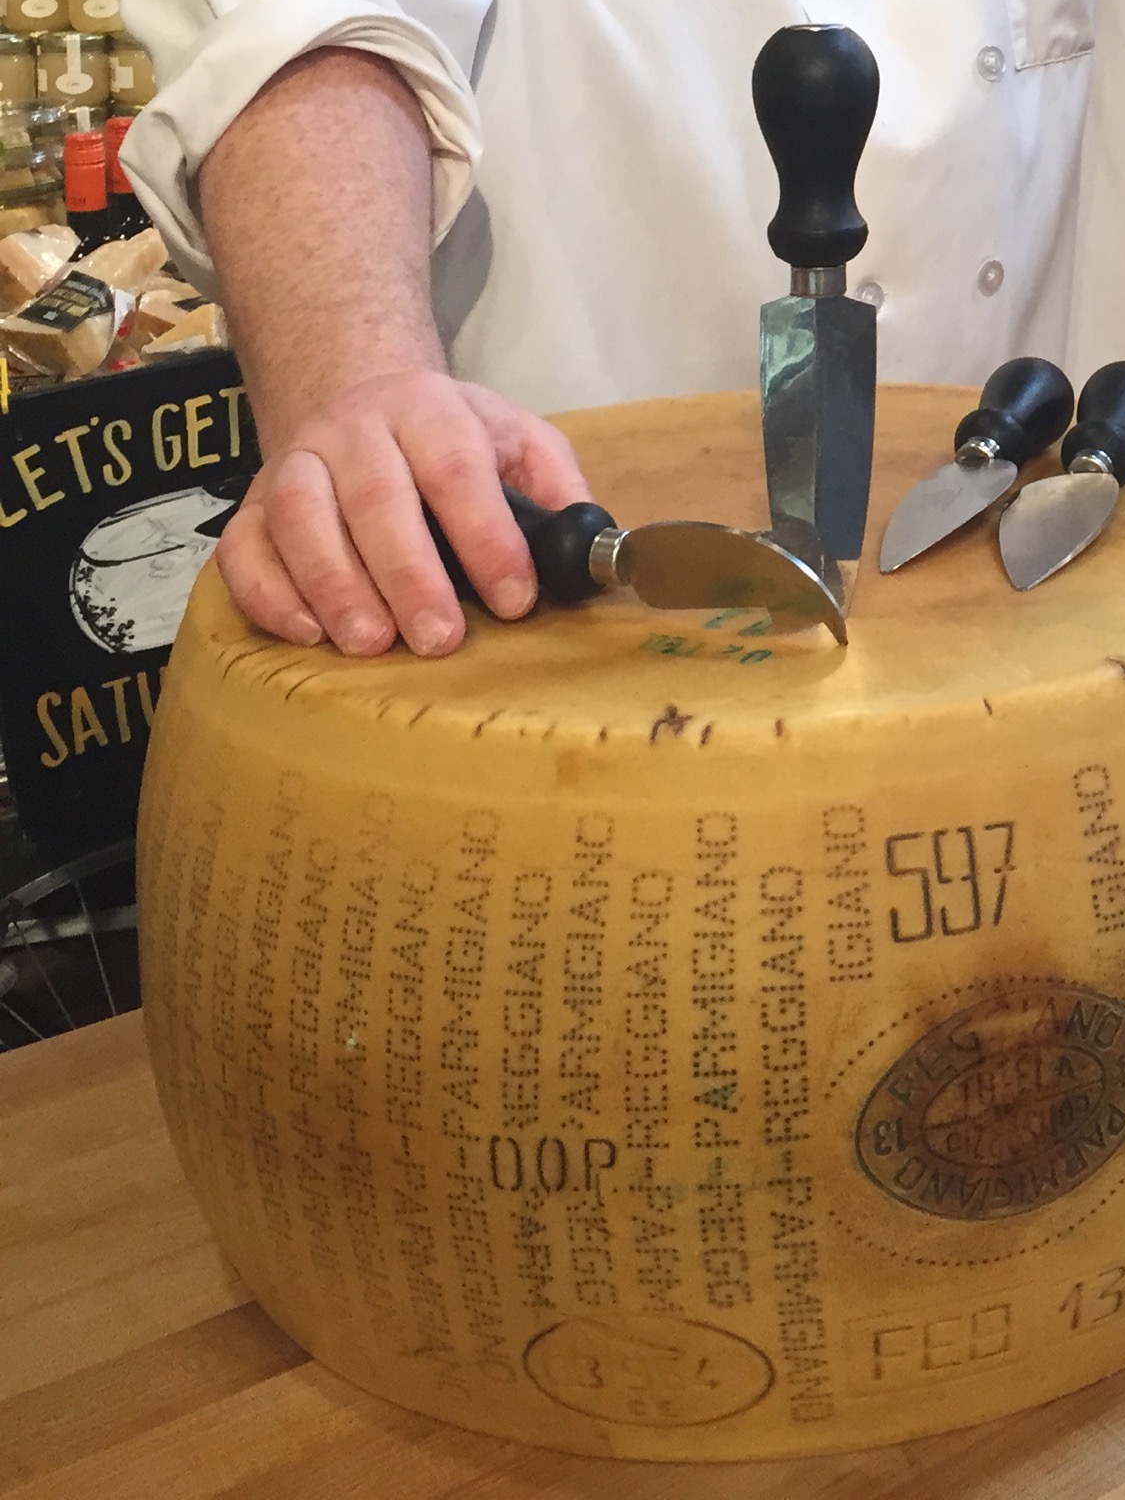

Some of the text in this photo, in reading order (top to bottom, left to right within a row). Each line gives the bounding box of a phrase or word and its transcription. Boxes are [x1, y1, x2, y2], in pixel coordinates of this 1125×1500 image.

[0, 386, 254, 528] LET'S GET
[440, 808, 503, 1144] PARMIGIANO
[625, 868, 675, 1150] REGGIANO
[692, 809, 741, 1150] PARMIGIANO
[759, 864, 813, 1148] REGGIANO
[884, 820, 1017, 943] 597
